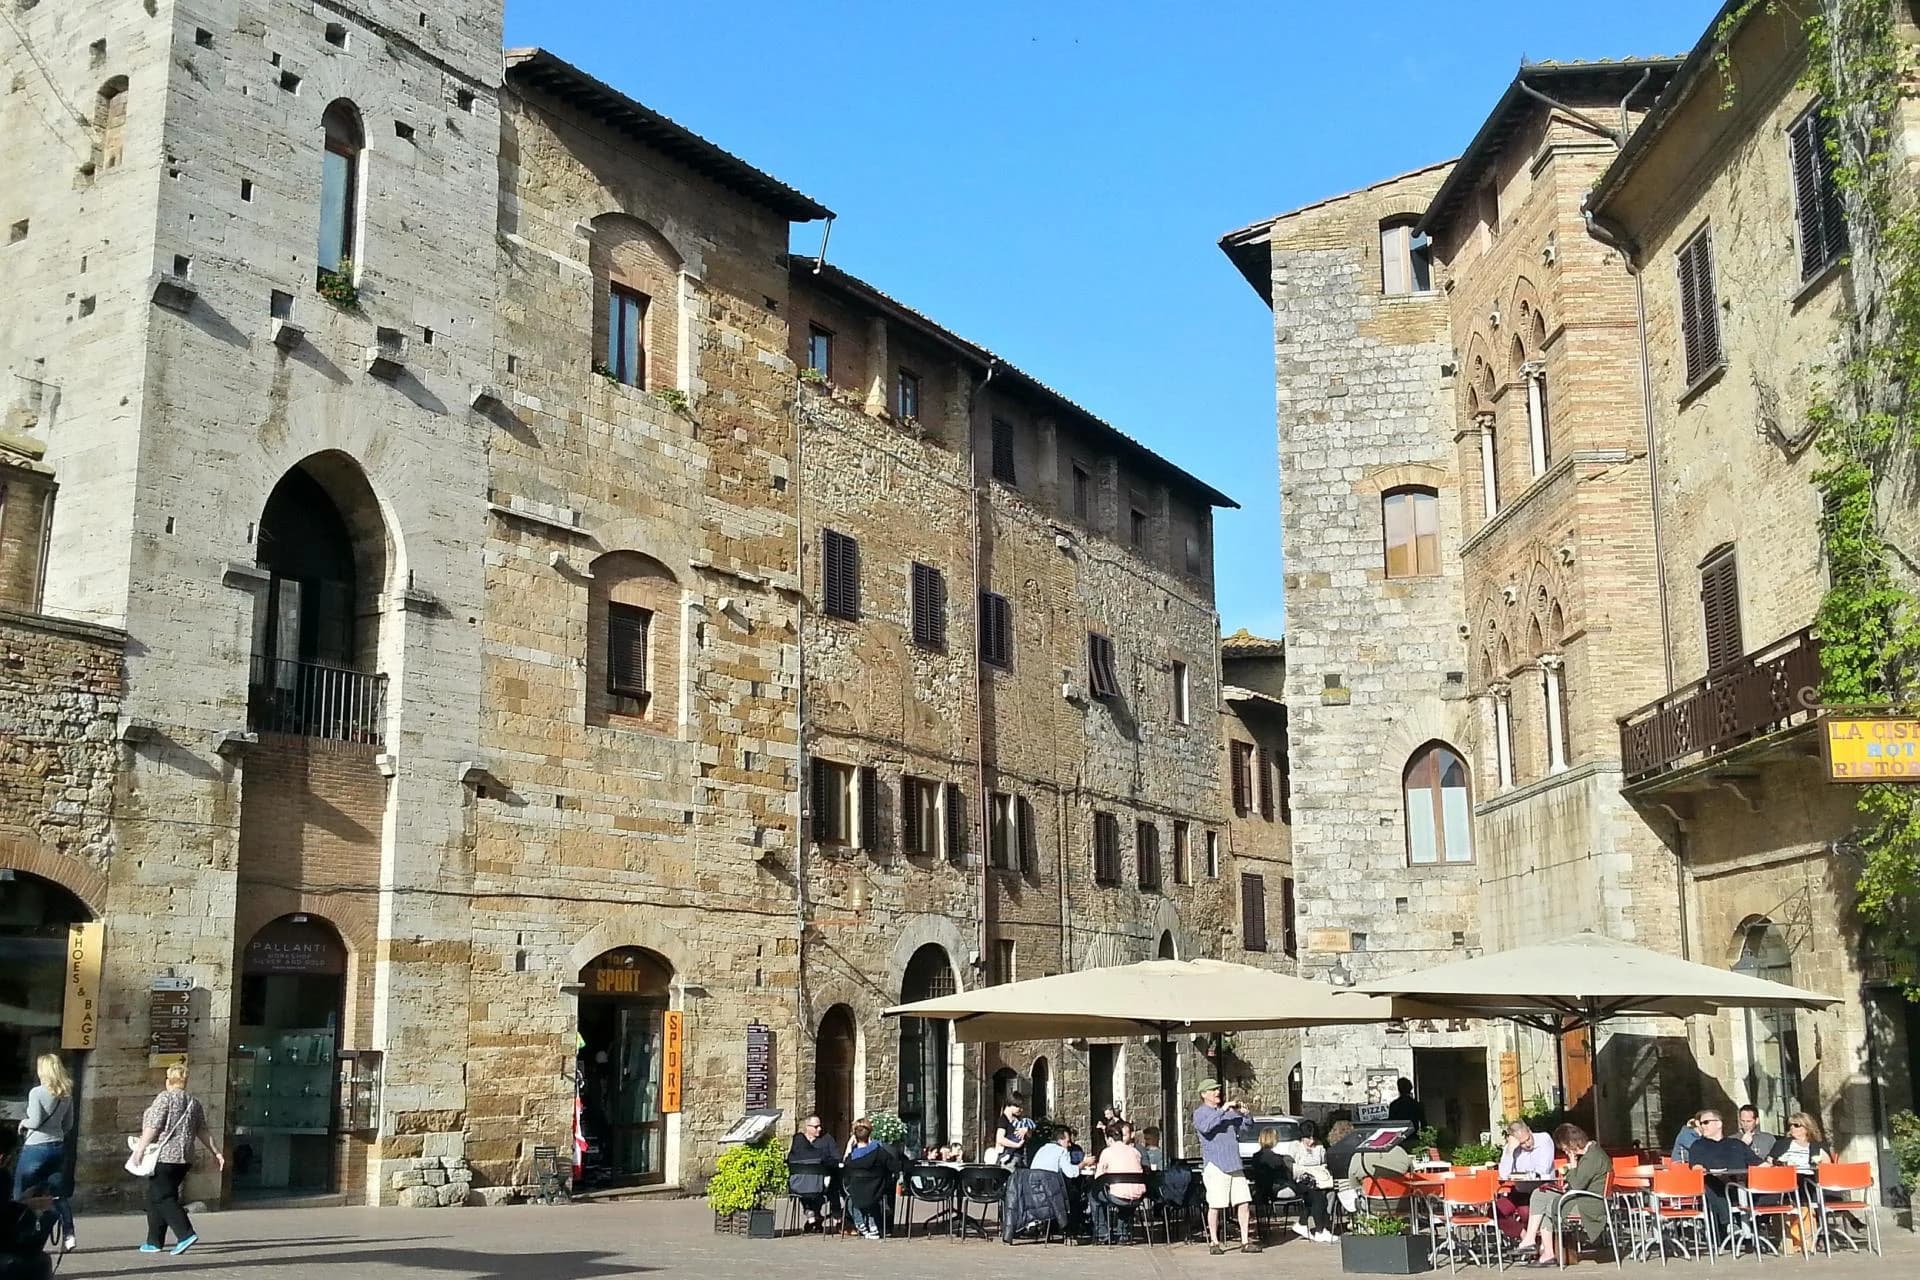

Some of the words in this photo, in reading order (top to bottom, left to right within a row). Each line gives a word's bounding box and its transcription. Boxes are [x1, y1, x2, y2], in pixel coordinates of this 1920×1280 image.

[1831, 723, 1864, 740] LA
[1868, 742, 1916, 757] HOT
[72, 926, 84, 983] SHOES
[253, 942, 327, 952] PALLANTI
[596, 968, 640, 992] SPORT
[77, 987, 86, 996] &
[81, 1000, 93, 1046] BAGS
[667, 1015, 678, 1106] SPORT
[1361, 1105, 1387, 1115] PIZZA
